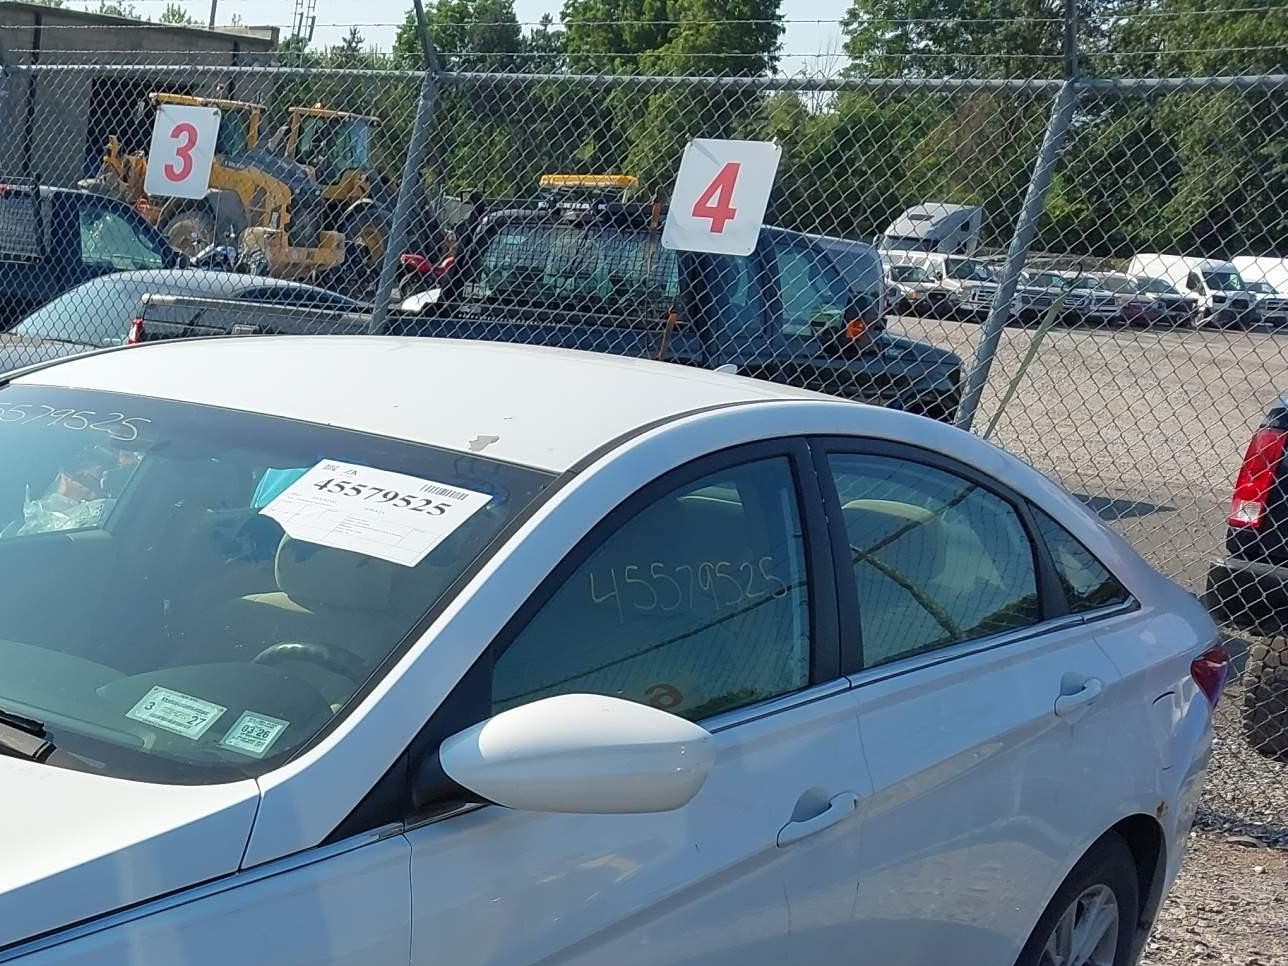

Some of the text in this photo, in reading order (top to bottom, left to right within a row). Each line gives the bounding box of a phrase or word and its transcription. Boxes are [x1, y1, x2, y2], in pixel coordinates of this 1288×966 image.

[164, 122, 199, 182] 3
[691, 161, 741, 235] 4
[313, 478, 453, 517] 45579525
[590, 557, 787, 624] 45579525
[144, 701, 156, 711] 3
[188, 715, 207, 727] 27
